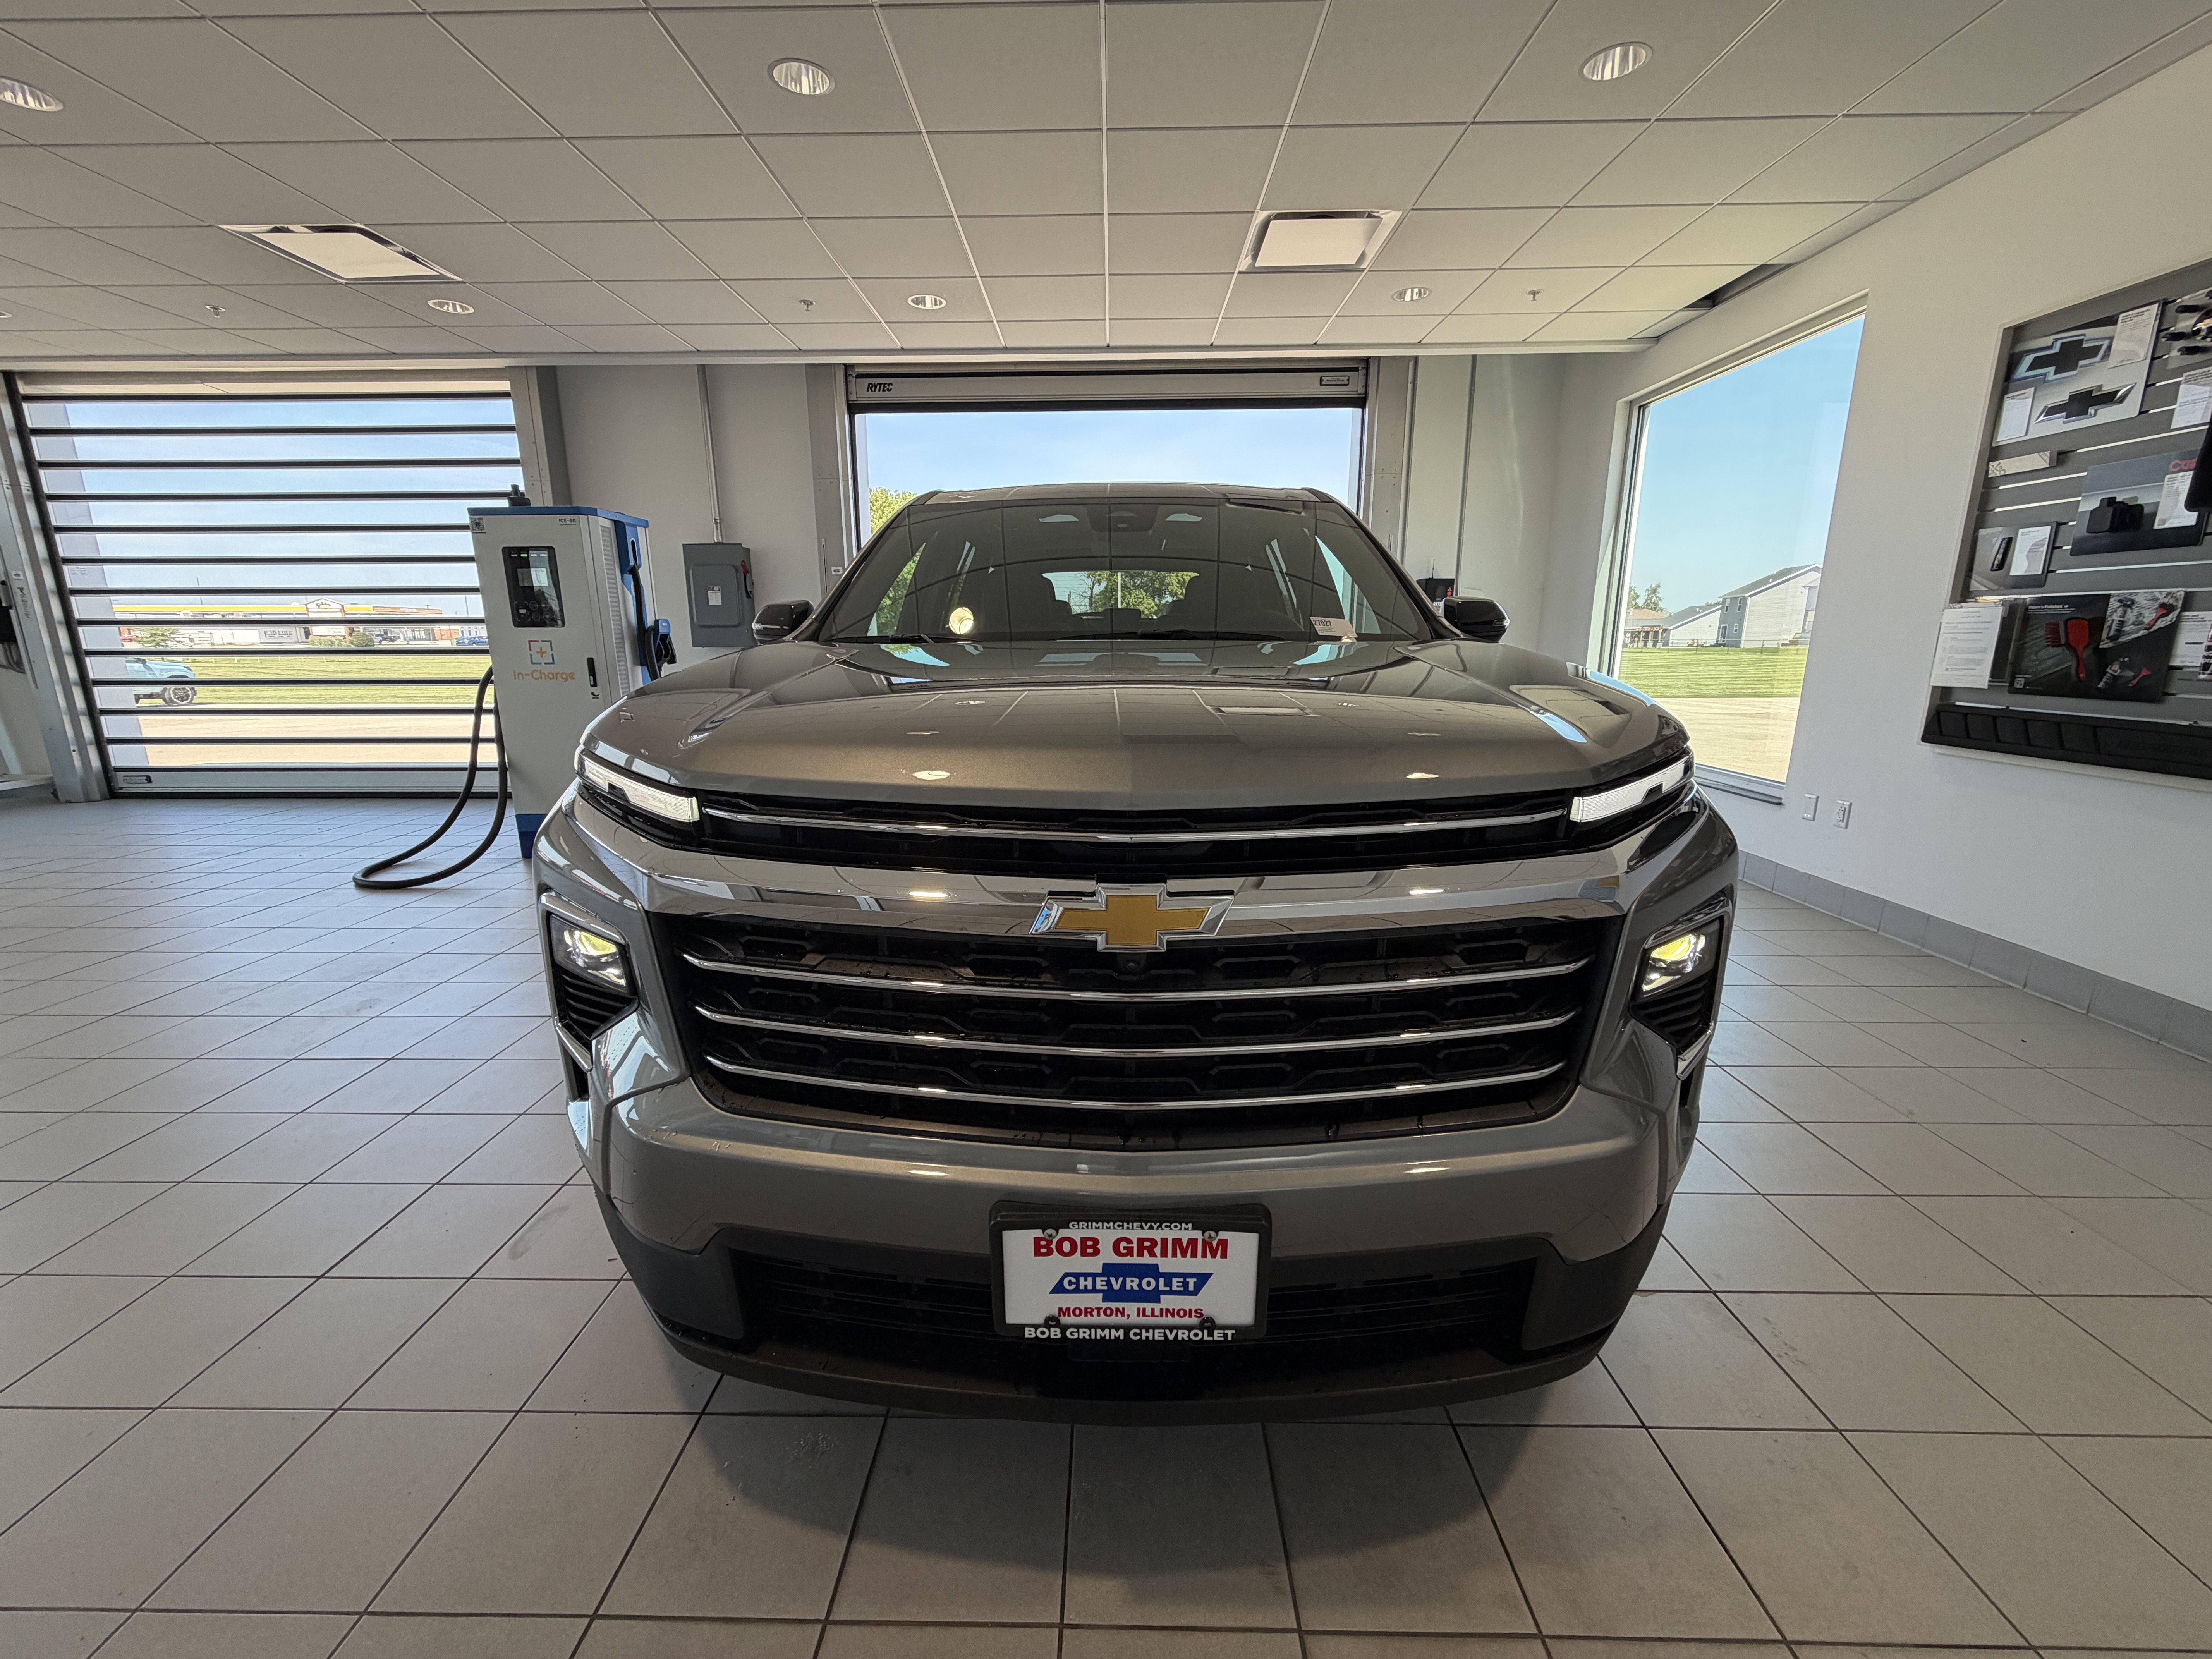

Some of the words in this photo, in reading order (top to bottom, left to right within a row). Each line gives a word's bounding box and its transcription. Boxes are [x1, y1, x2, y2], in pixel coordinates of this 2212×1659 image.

[867, 383, 893, 392] RYTEC
[513, 670, 575, 682] In-Charge
[1069, 1221, 1192, 1231] GRIMMCHEVY.COM
[1033, 1237, 1101, 1257] BOB
[1112, 1237, 1228, 1259] GRIMM
[1063, 1276, 1197, 1291] CHEVROLET
[1057, 1307, 1132, 1320] MORTON,
[1136, 1307, 1204, 1319] ILLINOIS
[1024, 1327, 1061, 1339] BOB
[1066, 1328, 1124, 1340] GRIMM
[1129, 1329, 1235, 1341] CHEVROLET
